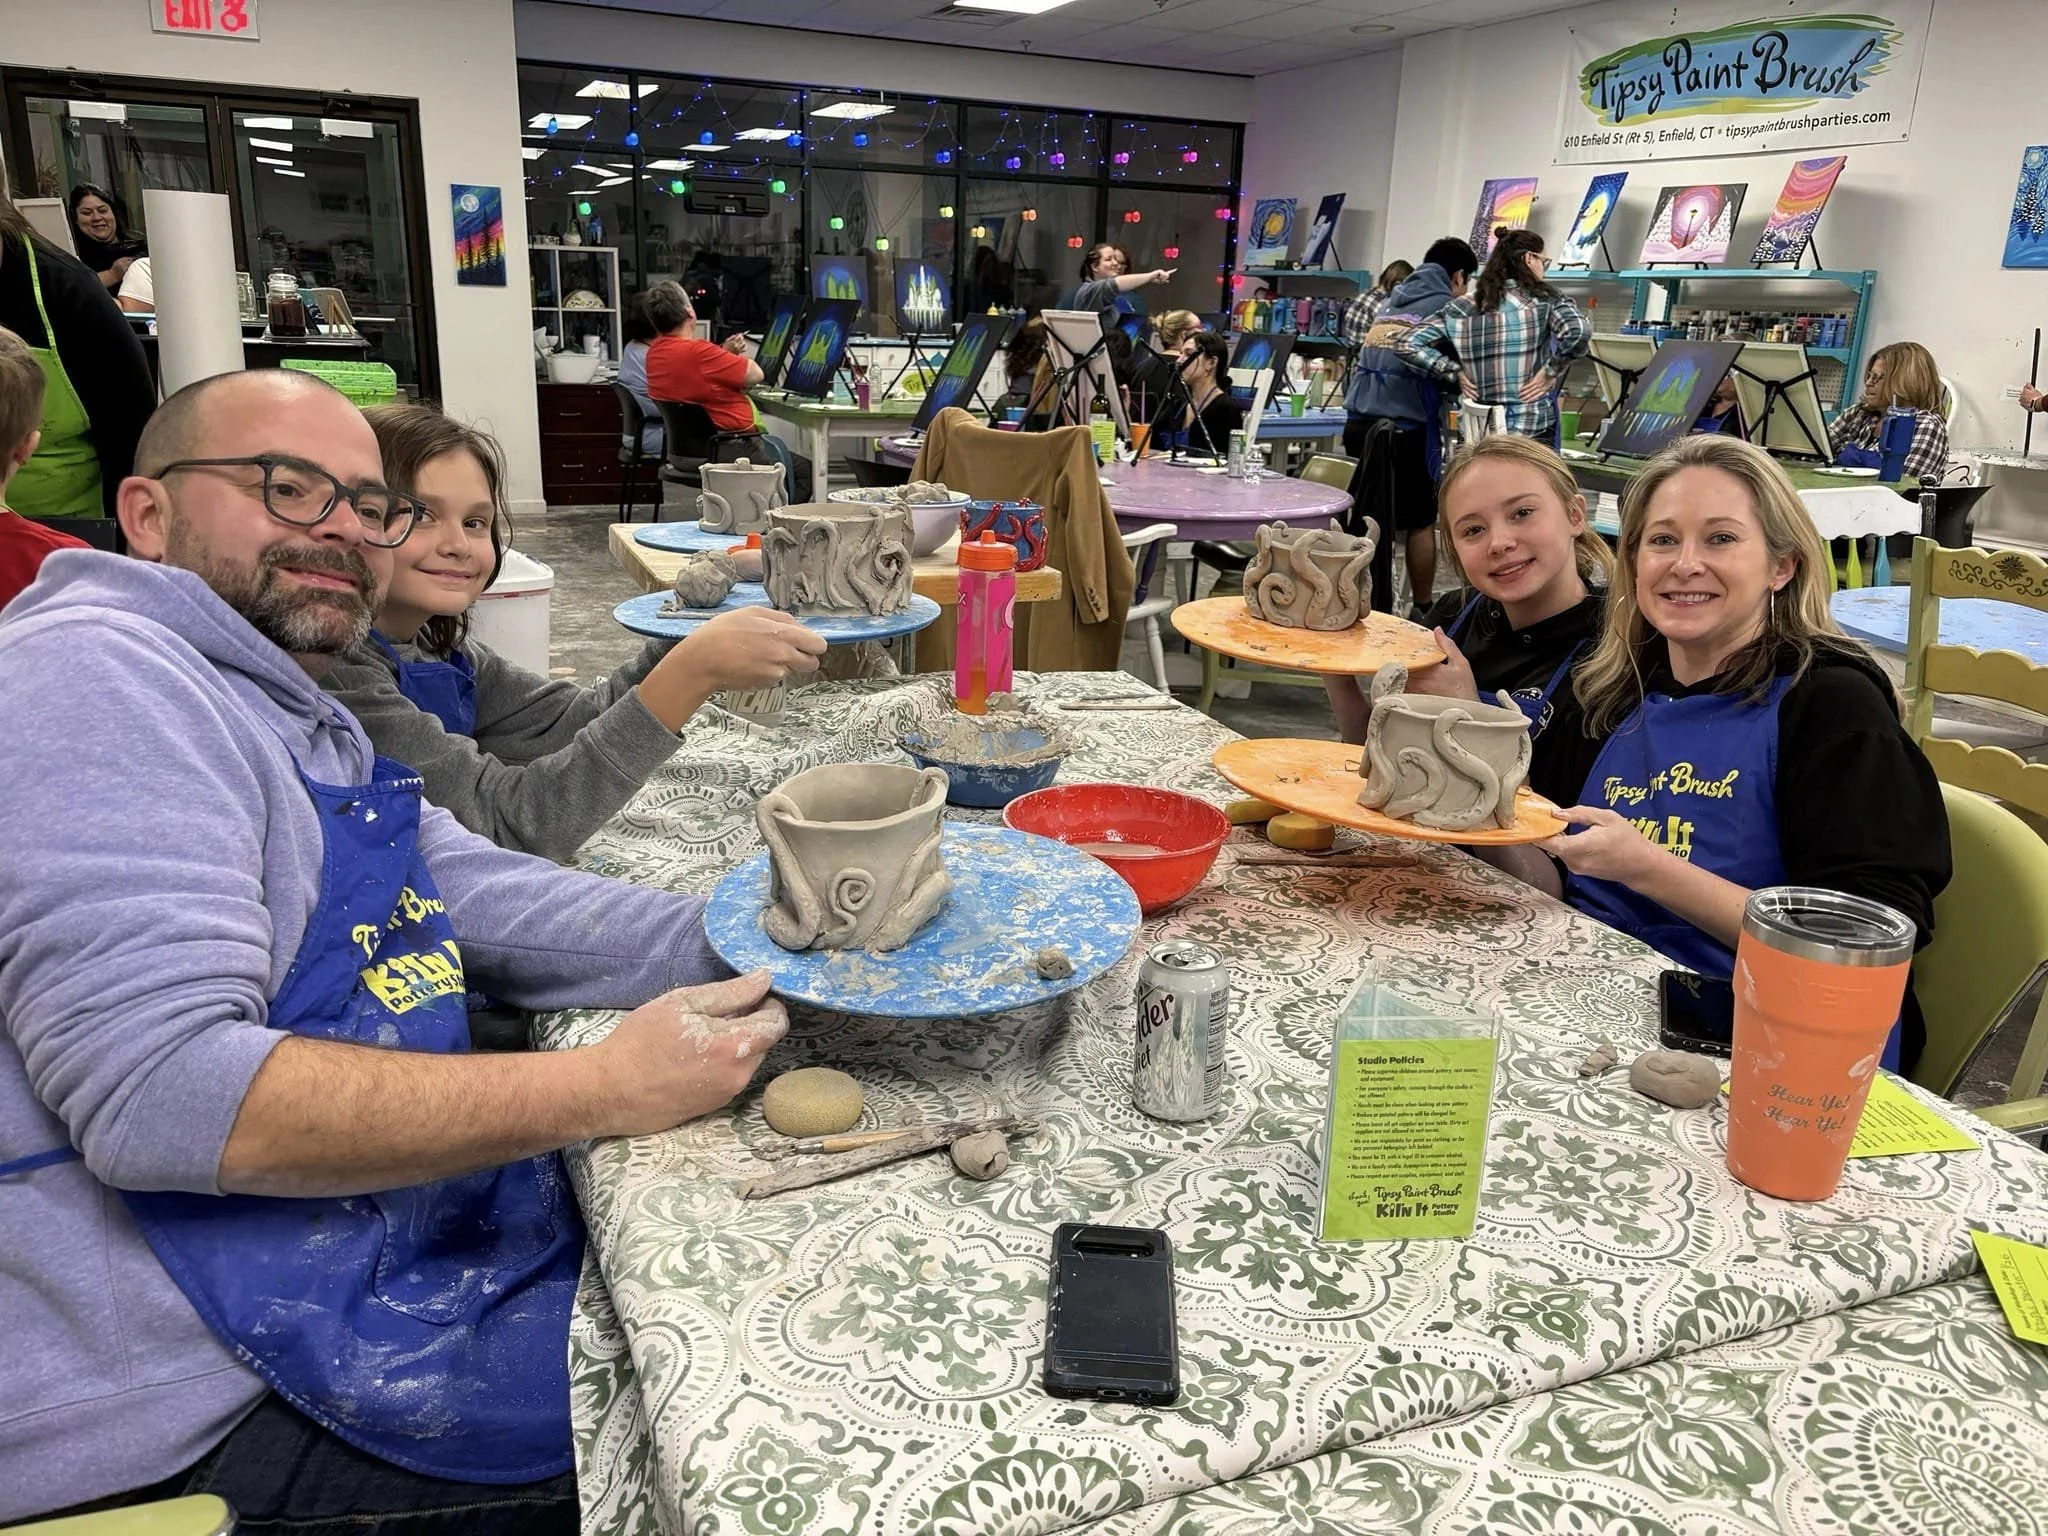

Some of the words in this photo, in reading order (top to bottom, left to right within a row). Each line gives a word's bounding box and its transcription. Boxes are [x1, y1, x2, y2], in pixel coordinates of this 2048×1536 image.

[1589, 66, 1665, 123] Tipsy
[1663, 38, 1748, 95] Paint
[1752, 31, 1876, 96] Brush
[1564, 136, 1579, 148] 610
[1581, 134, 1610, 147] Enfield
[1613, 133, 1623, 144] St
[1625, 132, 1641, 145] (Rt
[1643, 131, 1655, 144] 5),
[1659, 128, 1696, 142] Enfield,
[1700, 127, 1714, 139] CT
[1726, 112, 1891, 139] tipsypaintbrushparties.com
[1603, 777, 1648, 807] Tipsy
[1669, 762, 1739, 799] Brush
[1668, 816, 1695, 849] It
[401, 886, 445, 923] Bru
[1358, 1056, 1387, 1064] Studio
[1390, 1056, 1424, 1064] Policies
[1767, 1084, 1815, 1108] Hear
[1819, 1094, 1851, 1112] Ye!
[1762, 1105, 1810, 1128] Hear
[1816, 1116, 1846, 1134] Ye!
[1373, 1186, 1401, 1201] Tipsy
[1402, 1185, 1429, 1197] Paint
[1429, 1183, 1462, 1197] Brush
[1416, 1203, 1428, 1216] It
